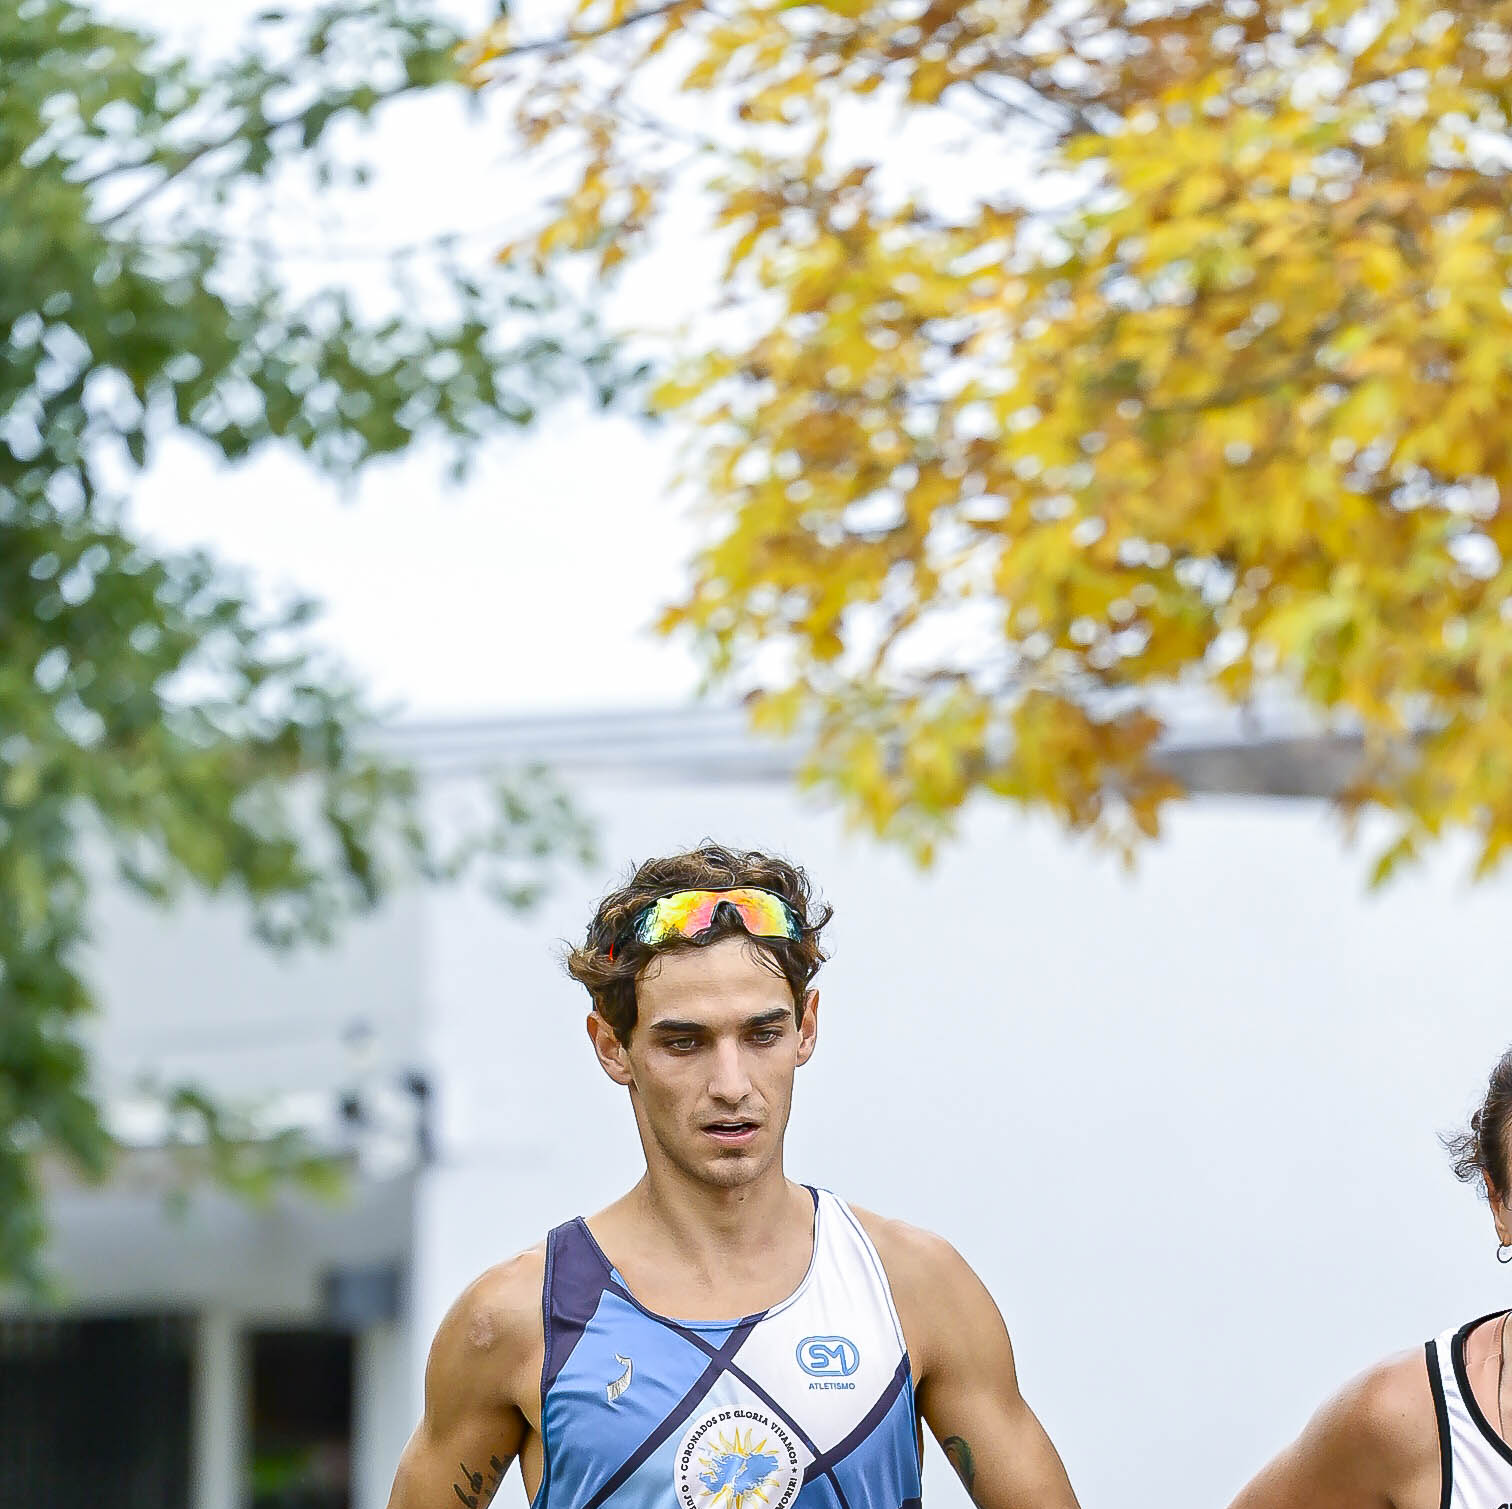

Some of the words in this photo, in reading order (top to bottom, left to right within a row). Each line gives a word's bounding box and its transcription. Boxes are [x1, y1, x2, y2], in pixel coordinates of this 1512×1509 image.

[808, 1382, 856, 1390] ATLETISMO
[681, 1416, 718, 1472] CORONADOS
[718, 1411, 732, 1422] DE
[733, 1410, 769, 1426] GLORIA
[770, 1421, 798, 1465] VIVAMOS
